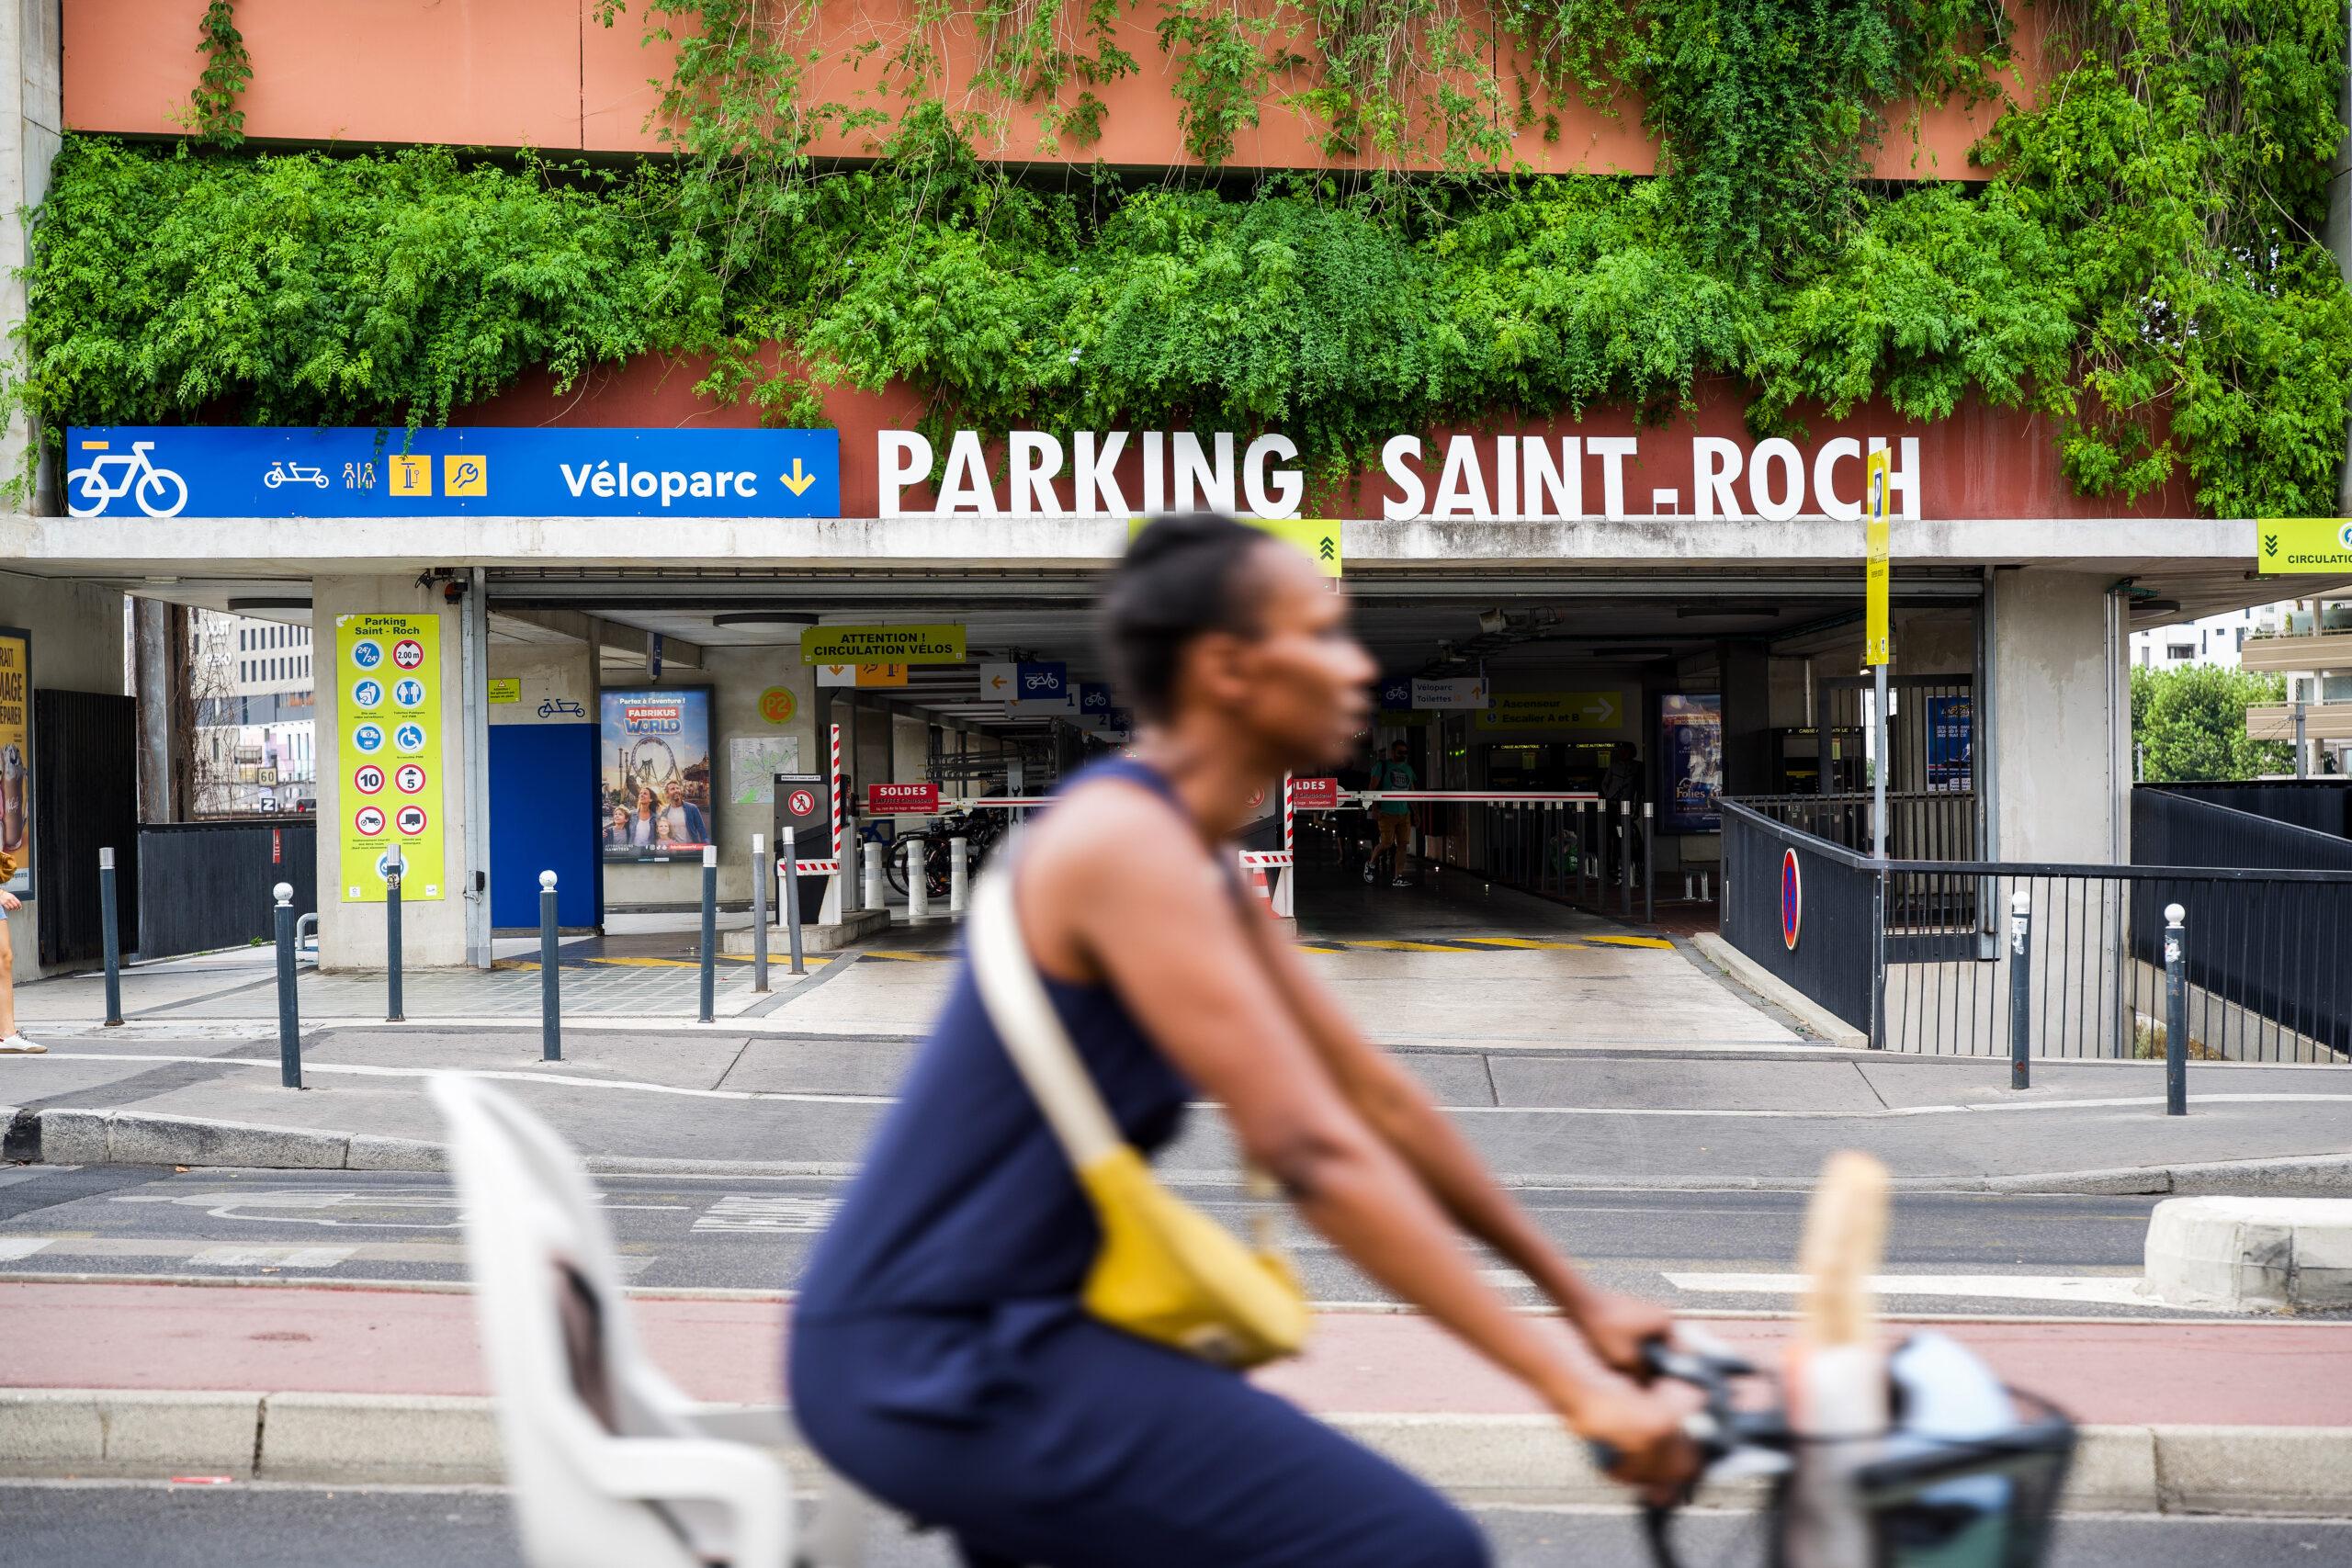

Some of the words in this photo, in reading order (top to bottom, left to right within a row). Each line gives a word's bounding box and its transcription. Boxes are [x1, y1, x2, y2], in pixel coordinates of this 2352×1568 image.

[878, 430, 1304, 519] PARKING
[1382, 434, 1637, 521] SAINT
[1693, 437, 1921, 521] ROCH
[560, 460, 757, 506] Véloparc
[365, 617, 407, 626] Parking
[355, 626, 382, 635] Saint
[393, 626, 420, 635] Roch
[841, 634, 918, 645] ATTENTION
[814, 645, 905, 656] CIRCULATION
[907, 643, 953, 655] VÉLOS
[398, 651, 412, 660] 2.00
[1418, 683, 1453, 693] Véloparc
[1067, 693, 1075, 706] 1
[1502, 699, 1560, 708] Ascenseur
[766, 696, 788, 714] P2
[628, 709, 676, 717] FABRIKUS
[1502, 714, 1544, 723] Escalier
[1547, 714, 1555, 722] A
[1558, 714, 1570, 722] et
[1572, 714, 1579, 722] B
[625, 718, 682, 735] WORLD
[261, 772, 274, 782] 60
[360, 773, 379, 787] 10
[407, 779, 415, 788] 5
[1294, 781, 1326, 791] LDES
[880, 786, 927, 796] SOLDES
